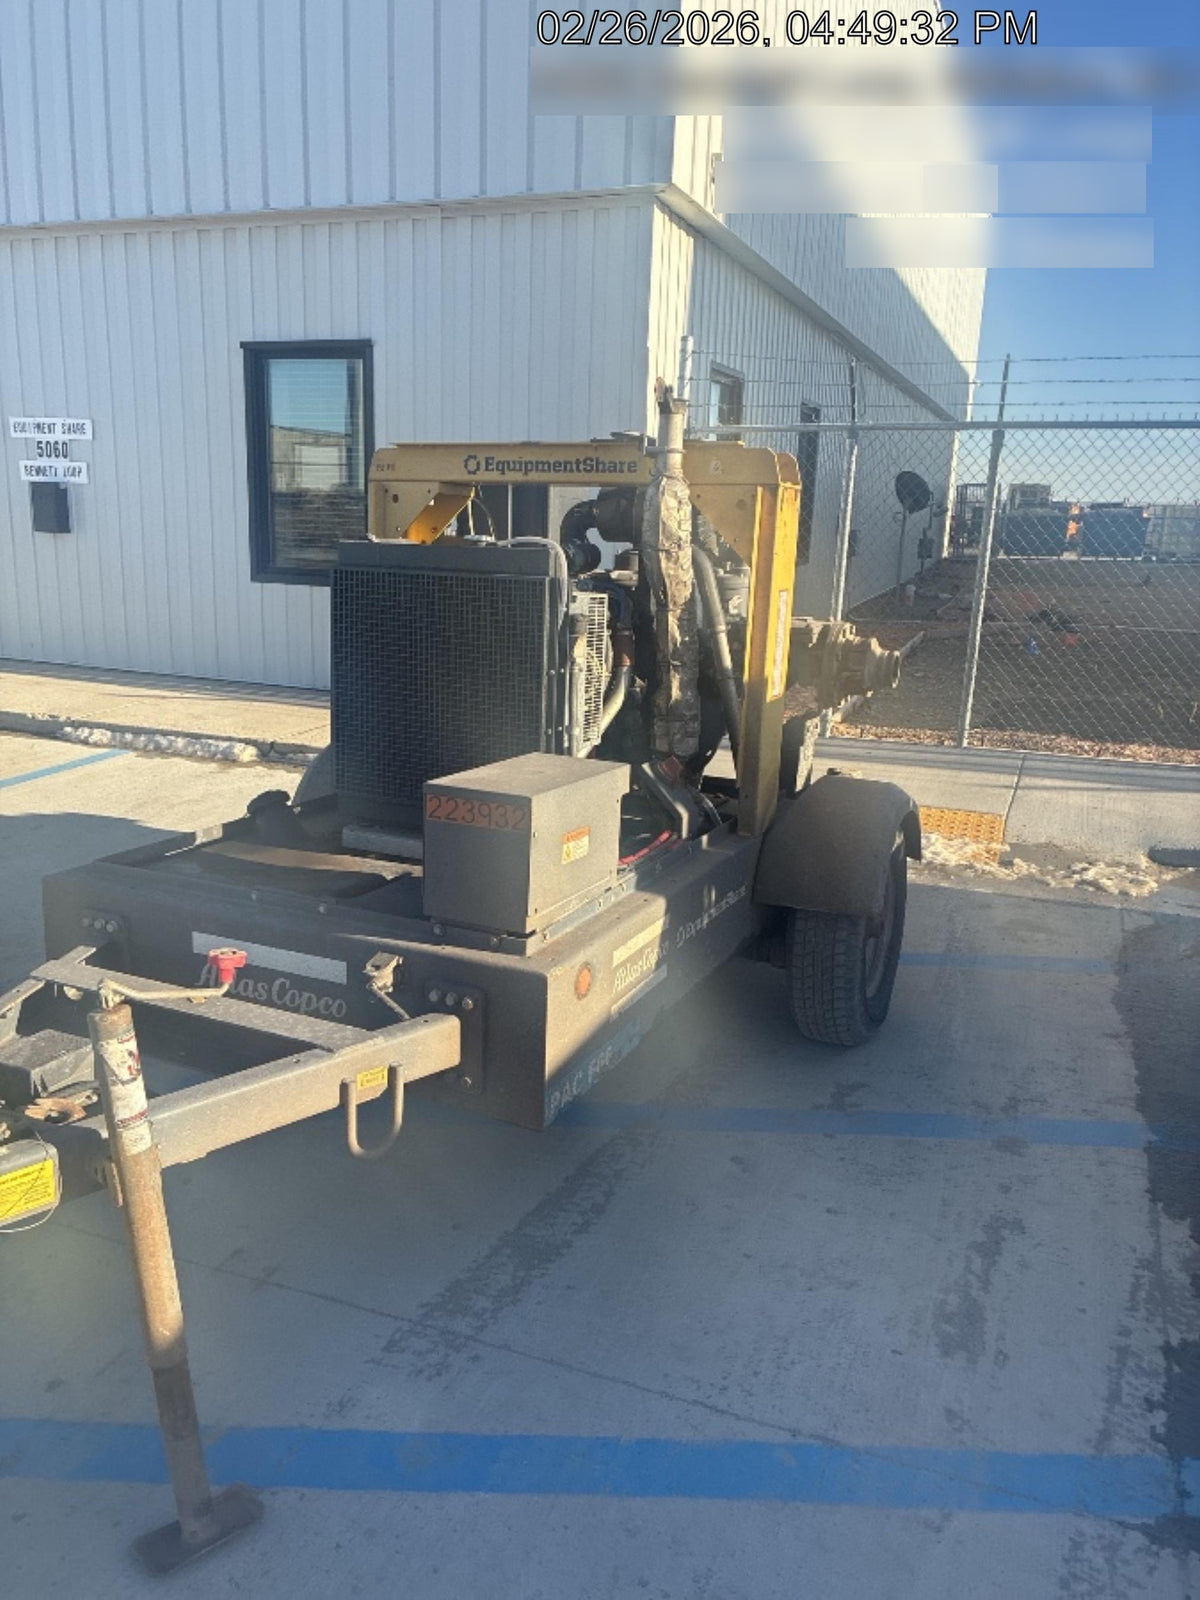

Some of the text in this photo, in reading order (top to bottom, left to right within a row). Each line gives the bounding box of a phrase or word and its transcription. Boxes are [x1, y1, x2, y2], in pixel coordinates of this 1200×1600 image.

[36, 440, 69, 459] 5060
[484, 456, 638, 476] EquipmentShare
[427, 795, 526, 830] 223932
[195, 961, 347, 1019] Alas Copco
